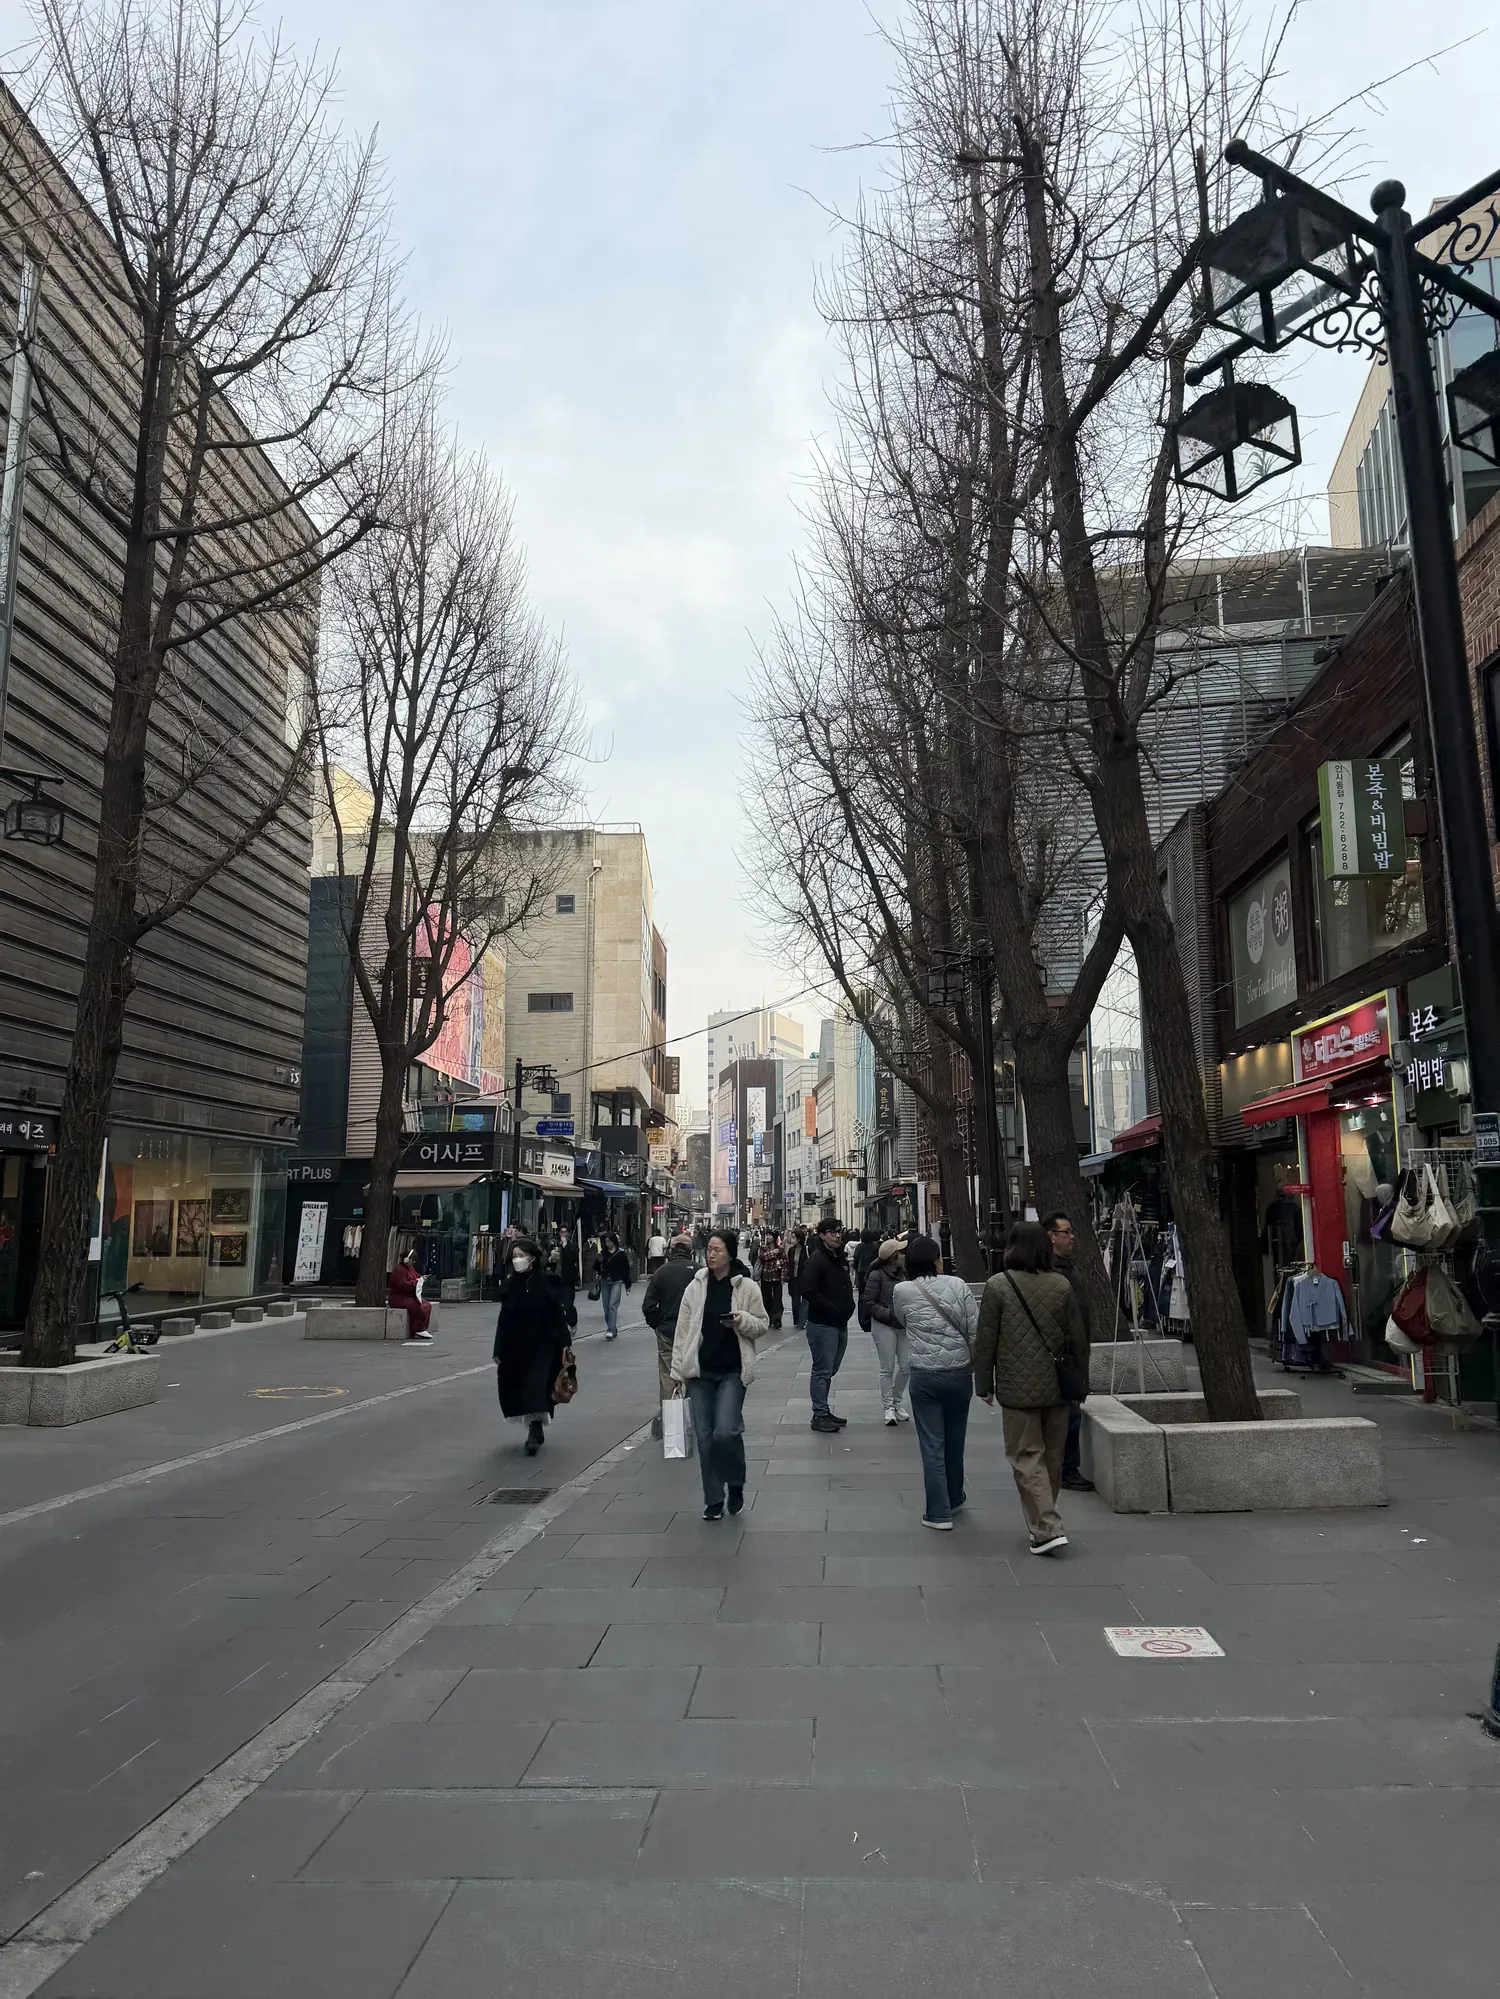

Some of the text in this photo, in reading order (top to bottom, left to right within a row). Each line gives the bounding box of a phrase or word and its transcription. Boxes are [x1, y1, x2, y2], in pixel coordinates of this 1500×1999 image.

[1334, 764, 1345, 798] 인사동점
[1406, 1056, 1445, 1094] 비빔밥
[19, 1120, 45, 1140] 이즈
[1477, 1137, 1498, 1147] 1005
[420, 1143, 485, 1163] 어사프
